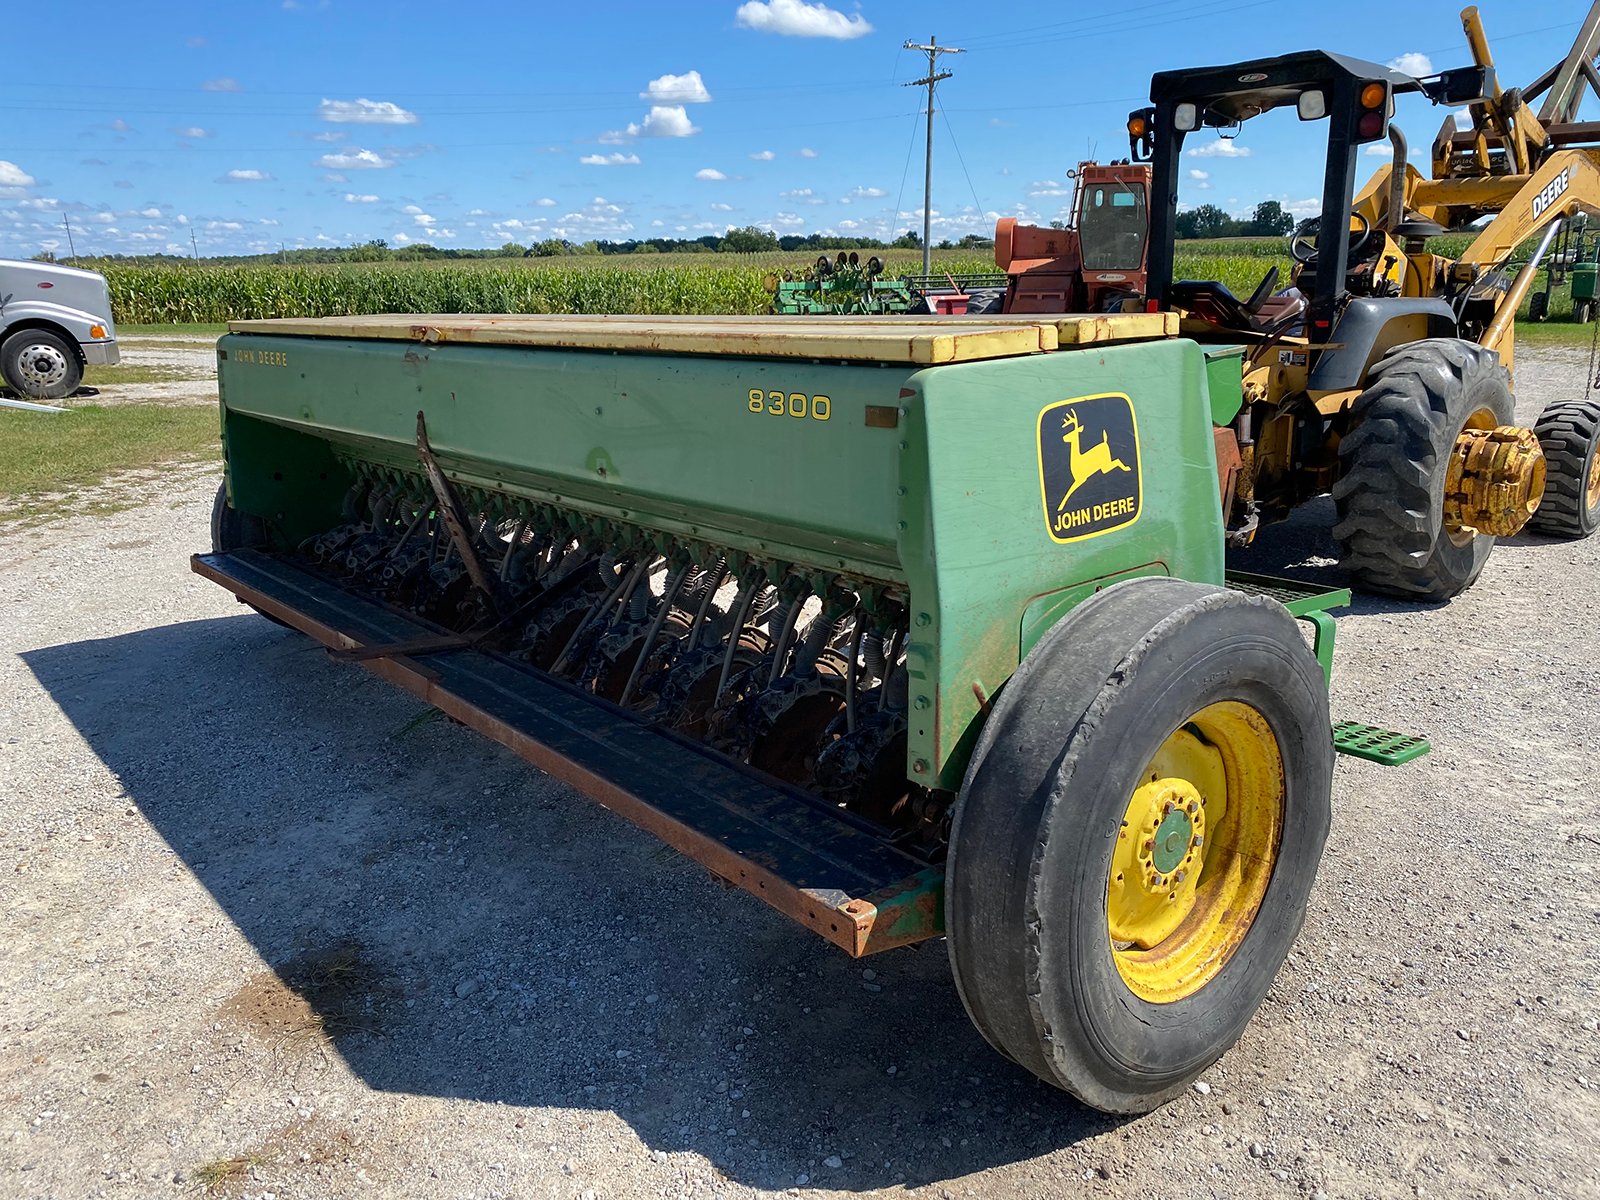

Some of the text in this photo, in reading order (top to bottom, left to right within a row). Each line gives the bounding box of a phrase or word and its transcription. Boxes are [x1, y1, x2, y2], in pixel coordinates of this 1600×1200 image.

[1532, 167, 1569, 221] DEERE
[234, 350, 287, 367] JOHN DEERE
[748, 388, 831, 421] 8300
[1054, 496, 1136, 532] JOHN DEERE
